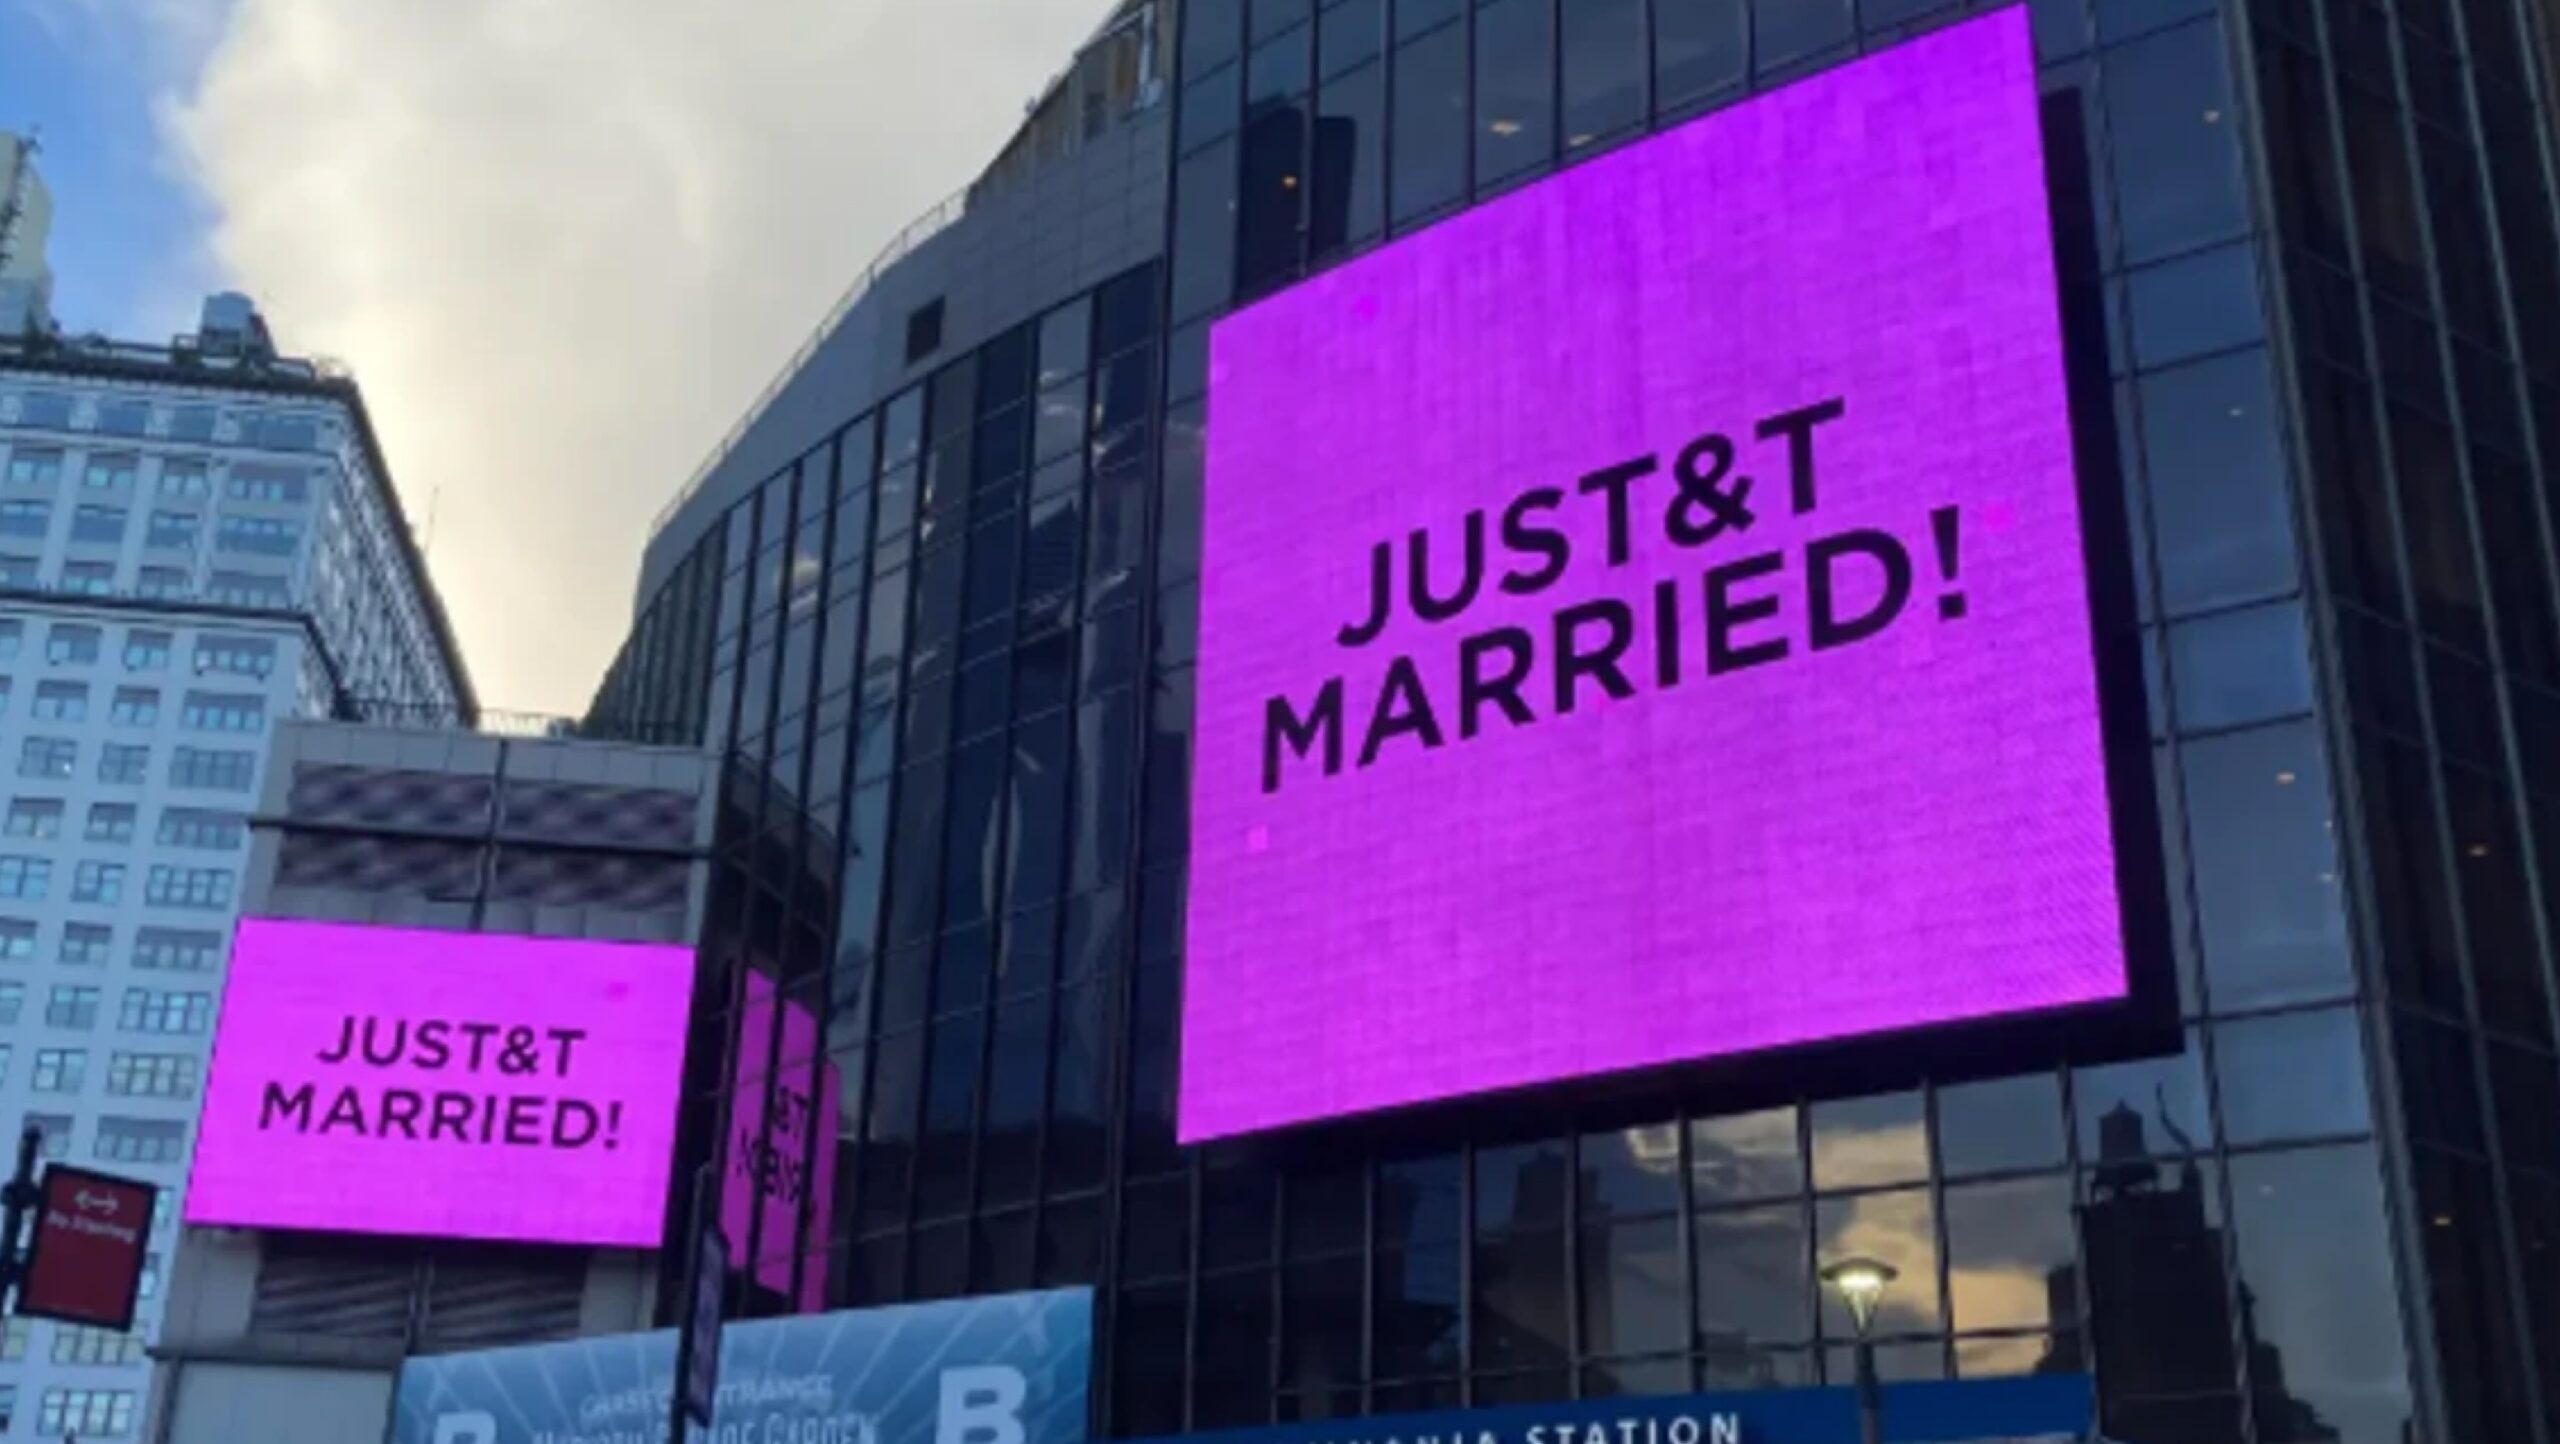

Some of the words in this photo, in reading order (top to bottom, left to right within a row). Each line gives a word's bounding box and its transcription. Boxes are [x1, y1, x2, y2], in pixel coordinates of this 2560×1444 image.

[1337, 398, 1844, 647] JUST&T
[1262, 505, 1966, 794] MARRIED!
[259, 1082, 622, 1150] MARRIED!
[316, 1016, 587, 1076] JUST&T
